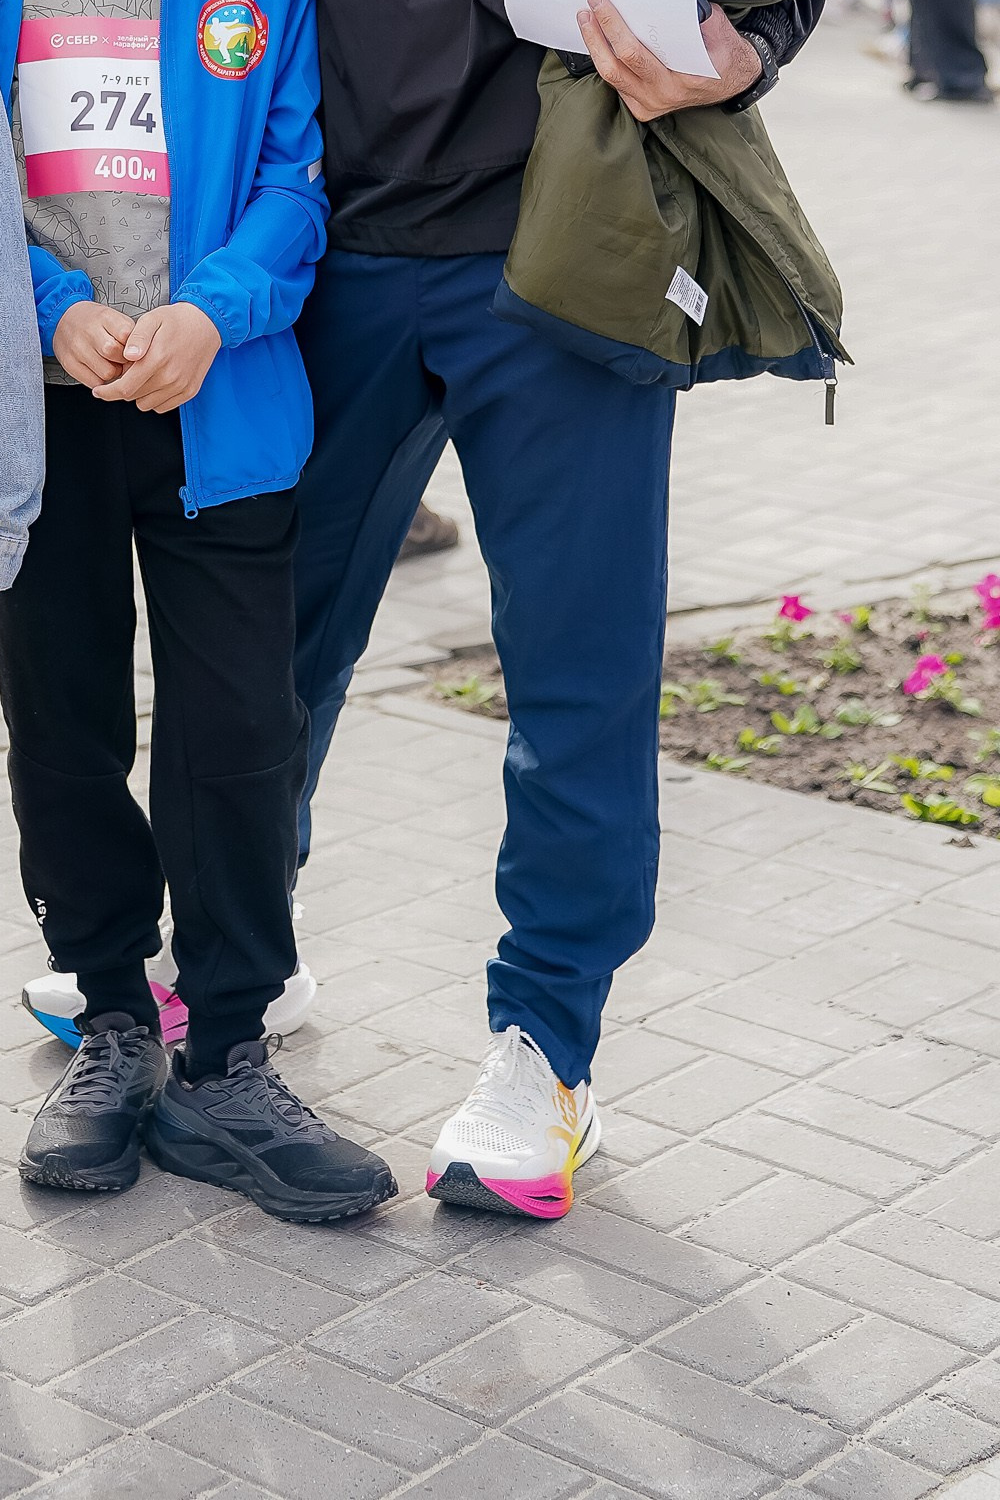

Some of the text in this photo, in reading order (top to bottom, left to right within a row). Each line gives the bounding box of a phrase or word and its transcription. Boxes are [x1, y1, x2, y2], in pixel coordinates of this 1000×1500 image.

[66, 35, 98, 45] СБЕР
[101, 74, 150, 86] 7-9 ЛЕТ
[70, 90, 157, 134] 274
